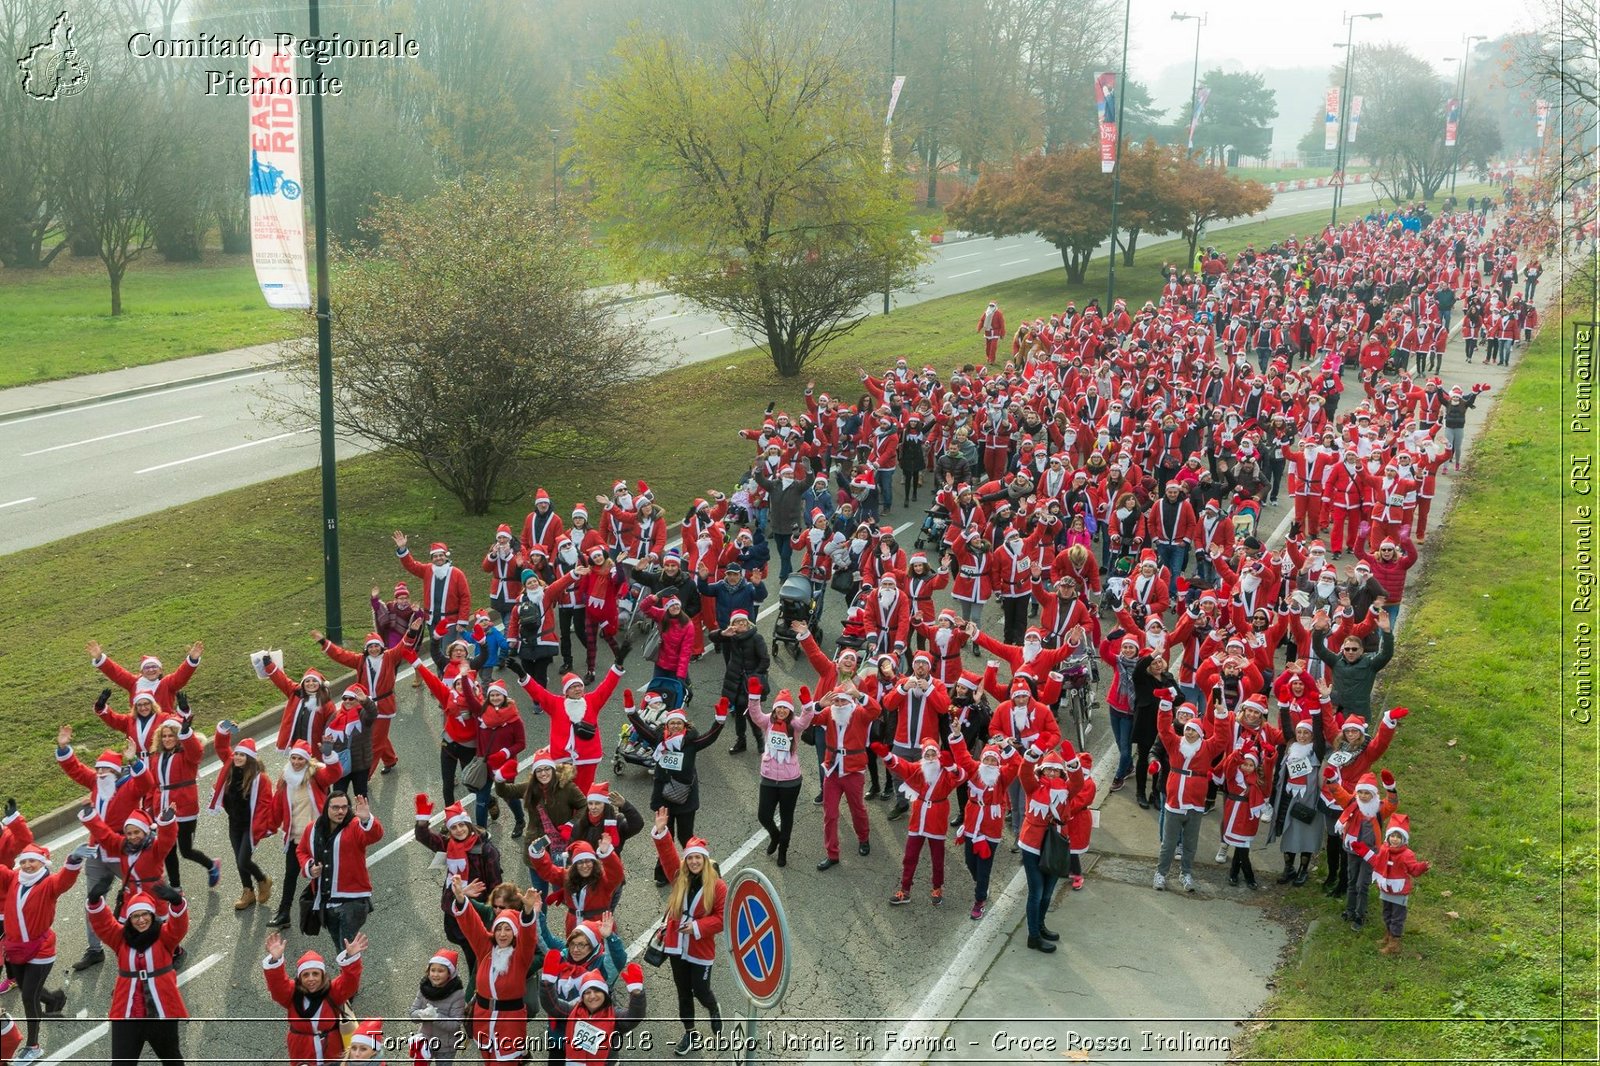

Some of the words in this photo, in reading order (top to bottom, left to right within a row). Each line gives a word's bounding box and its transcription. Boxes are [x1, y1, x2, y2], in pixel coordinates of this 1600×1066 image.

[252, 65, 271, 152] EASY
[271, 52, 295, 153] RIDER
[771, 736, 787, 746] 635
[663, 755, 679, 766] 668
[1333, 753, 1347, 764] 283
[1290, 761, 1307, 774] 284
[576, 1029, 597, 1046] 664
